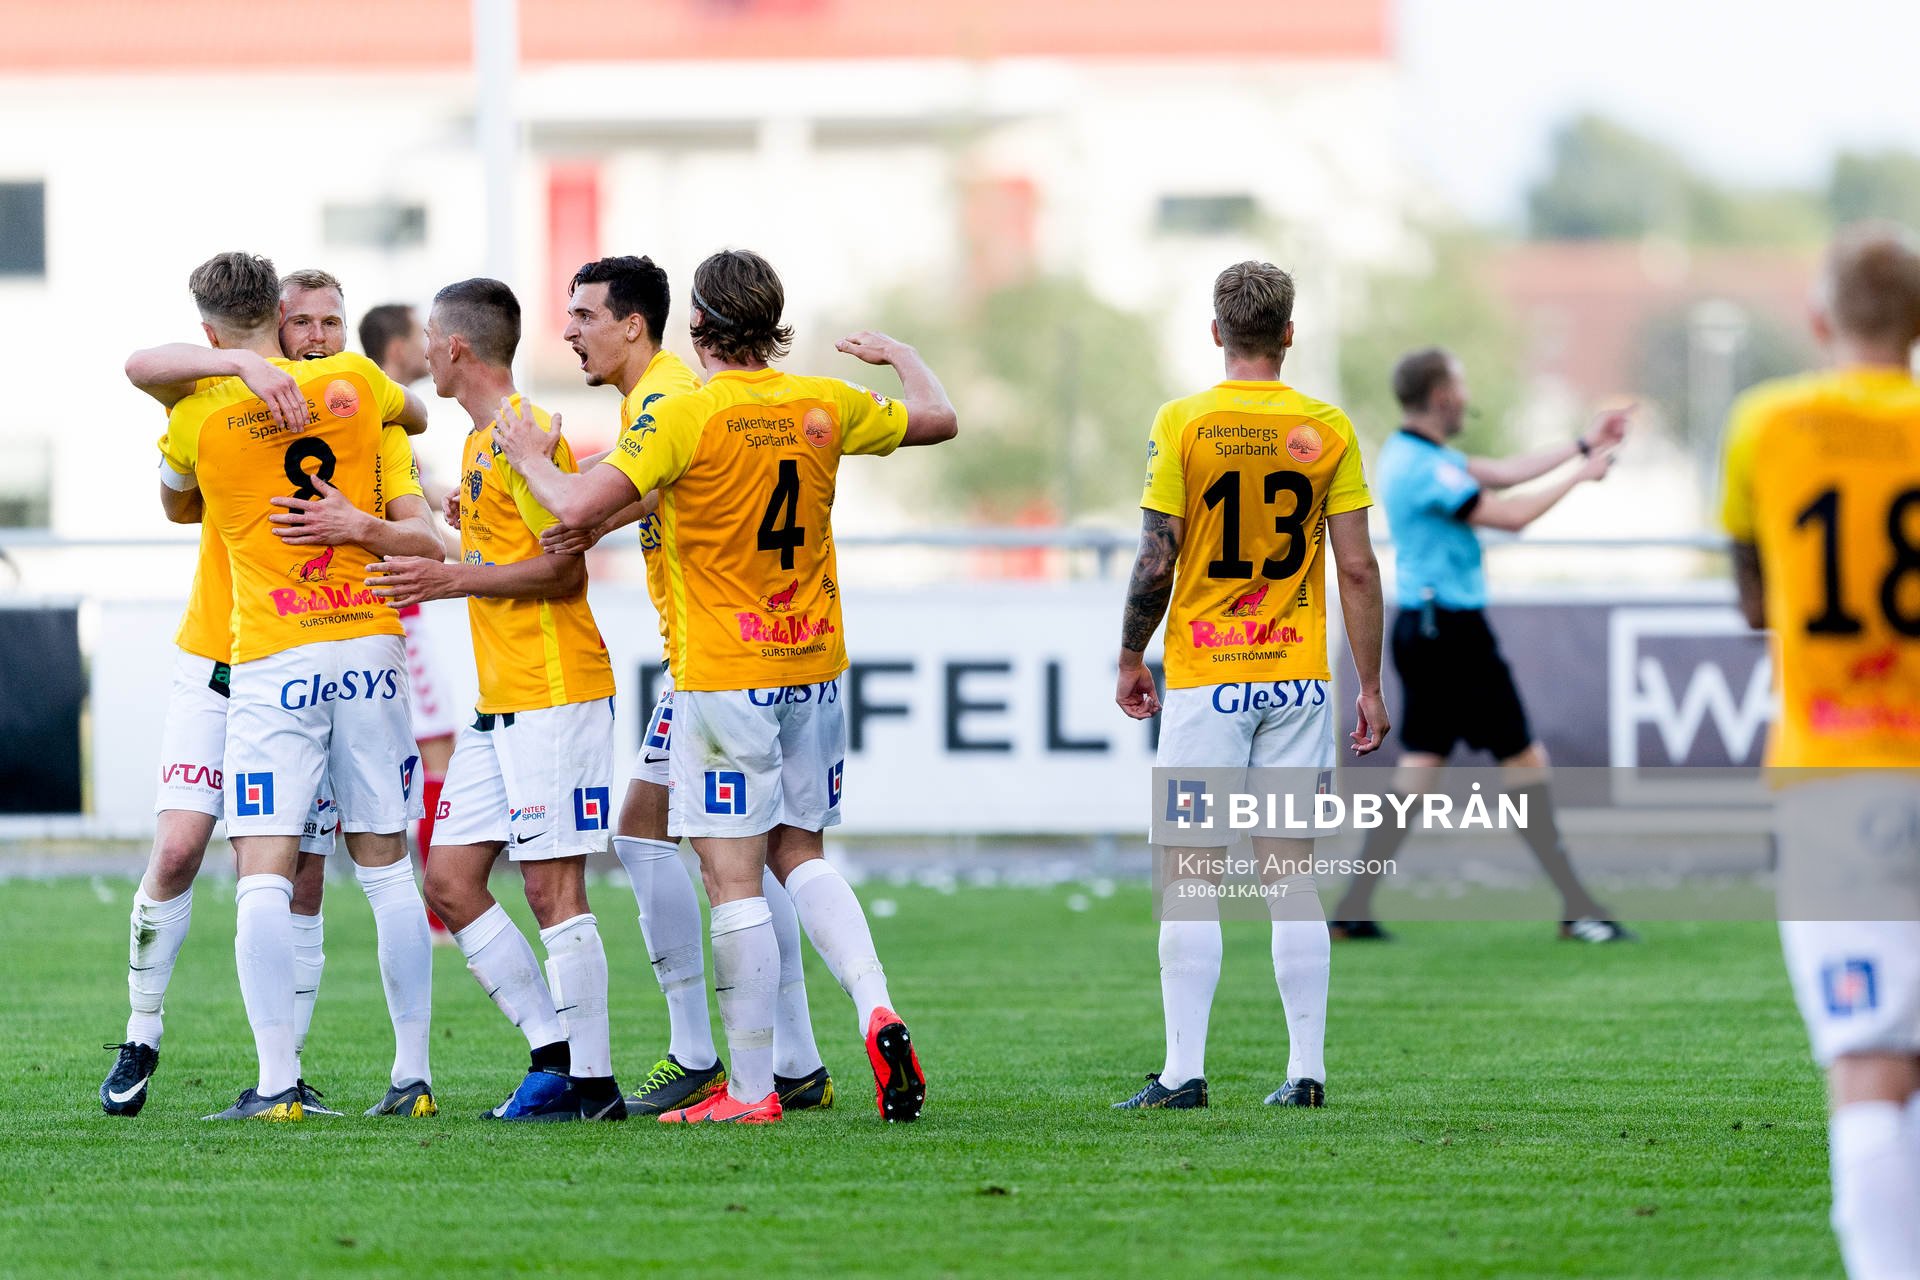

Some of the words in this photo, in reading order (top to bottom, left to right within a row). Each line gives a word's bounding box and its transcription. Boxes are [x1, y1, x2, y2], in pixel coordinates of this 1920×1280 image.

[1197, 424, 1279, 441] Falkenbergs
[1214, 441, 1279, 458] Sparbank
[757, 459, 805, 571] 4
[1202, 470, 1314, 581] 13
[1795, 485, 1920, 638] 18
[1188, 619, 1244, 649] Röda
[1212, 649, 1287, 663] SURSTRÖMMING
[280, 669, 397, 711] GleSYS
[1211, 679, 1327, 714] GleSYS
[521, 812, 546, 821] SPORT
